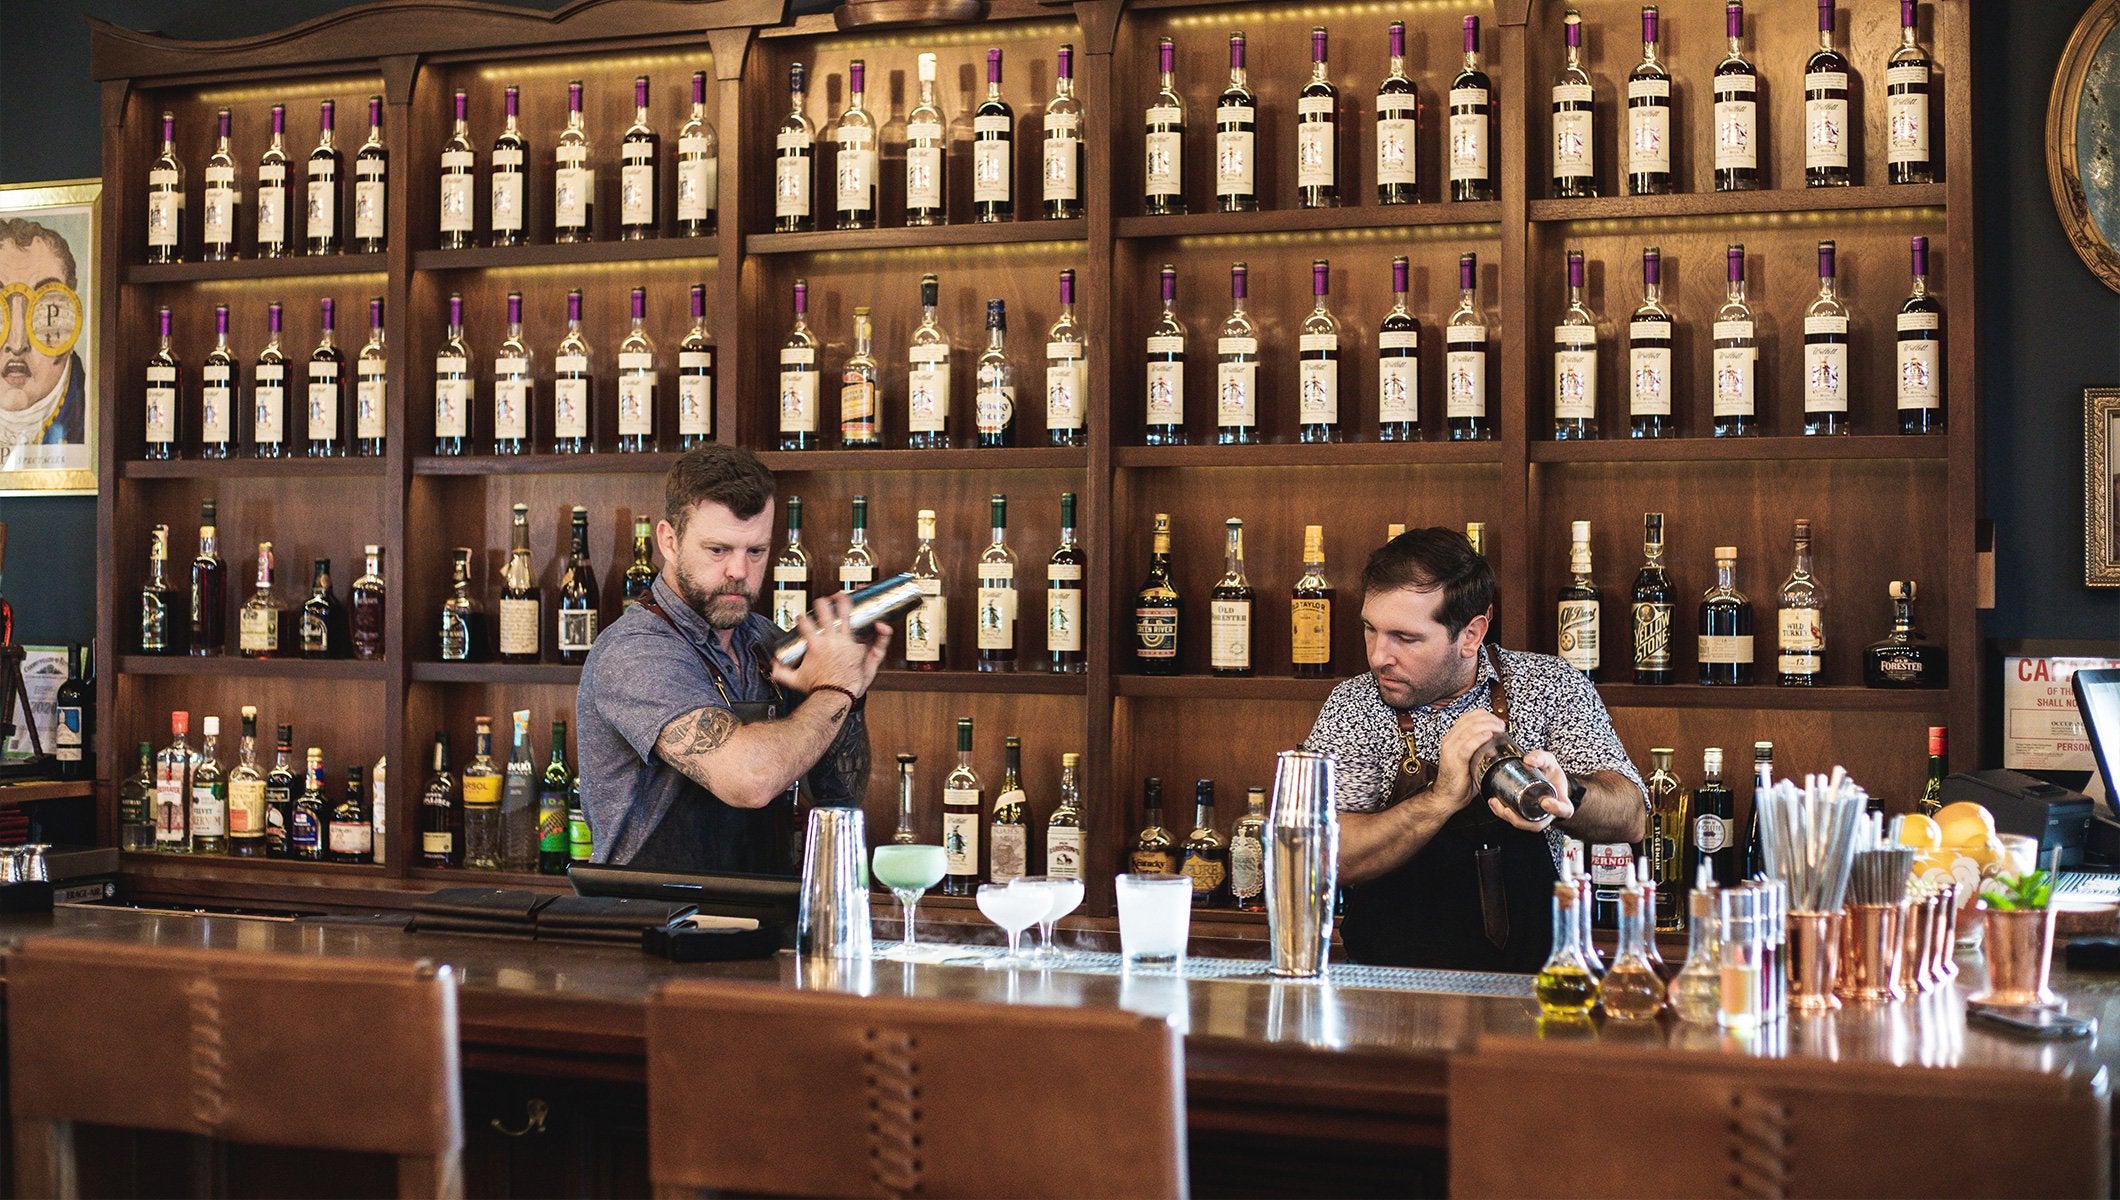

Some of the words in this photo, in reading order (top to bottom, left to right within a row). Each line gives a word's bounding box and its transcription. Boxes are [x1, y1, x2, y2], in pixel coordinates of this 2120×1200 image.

[47, 304, 59, 327] P
[1301, 601, 1326, 611] TAYLOR
[1154, 625, 1174, 633] RIVER
[1634, 608, 1671, 648] YELLOW
[1786, 622, 1804, 630] WILD
[1783, 629, 1808, 637] TURKEY
[1634, 628, 1669, 663] STONE
[1880, 660, 1922, 671] FORESTER
[2047, 687, 2058, 695] OF
[2037, 698, 2063, 707] SHALL
[2066, 699, 2078, 707] NO
[2057, 742, 2092, 752] PERSON
